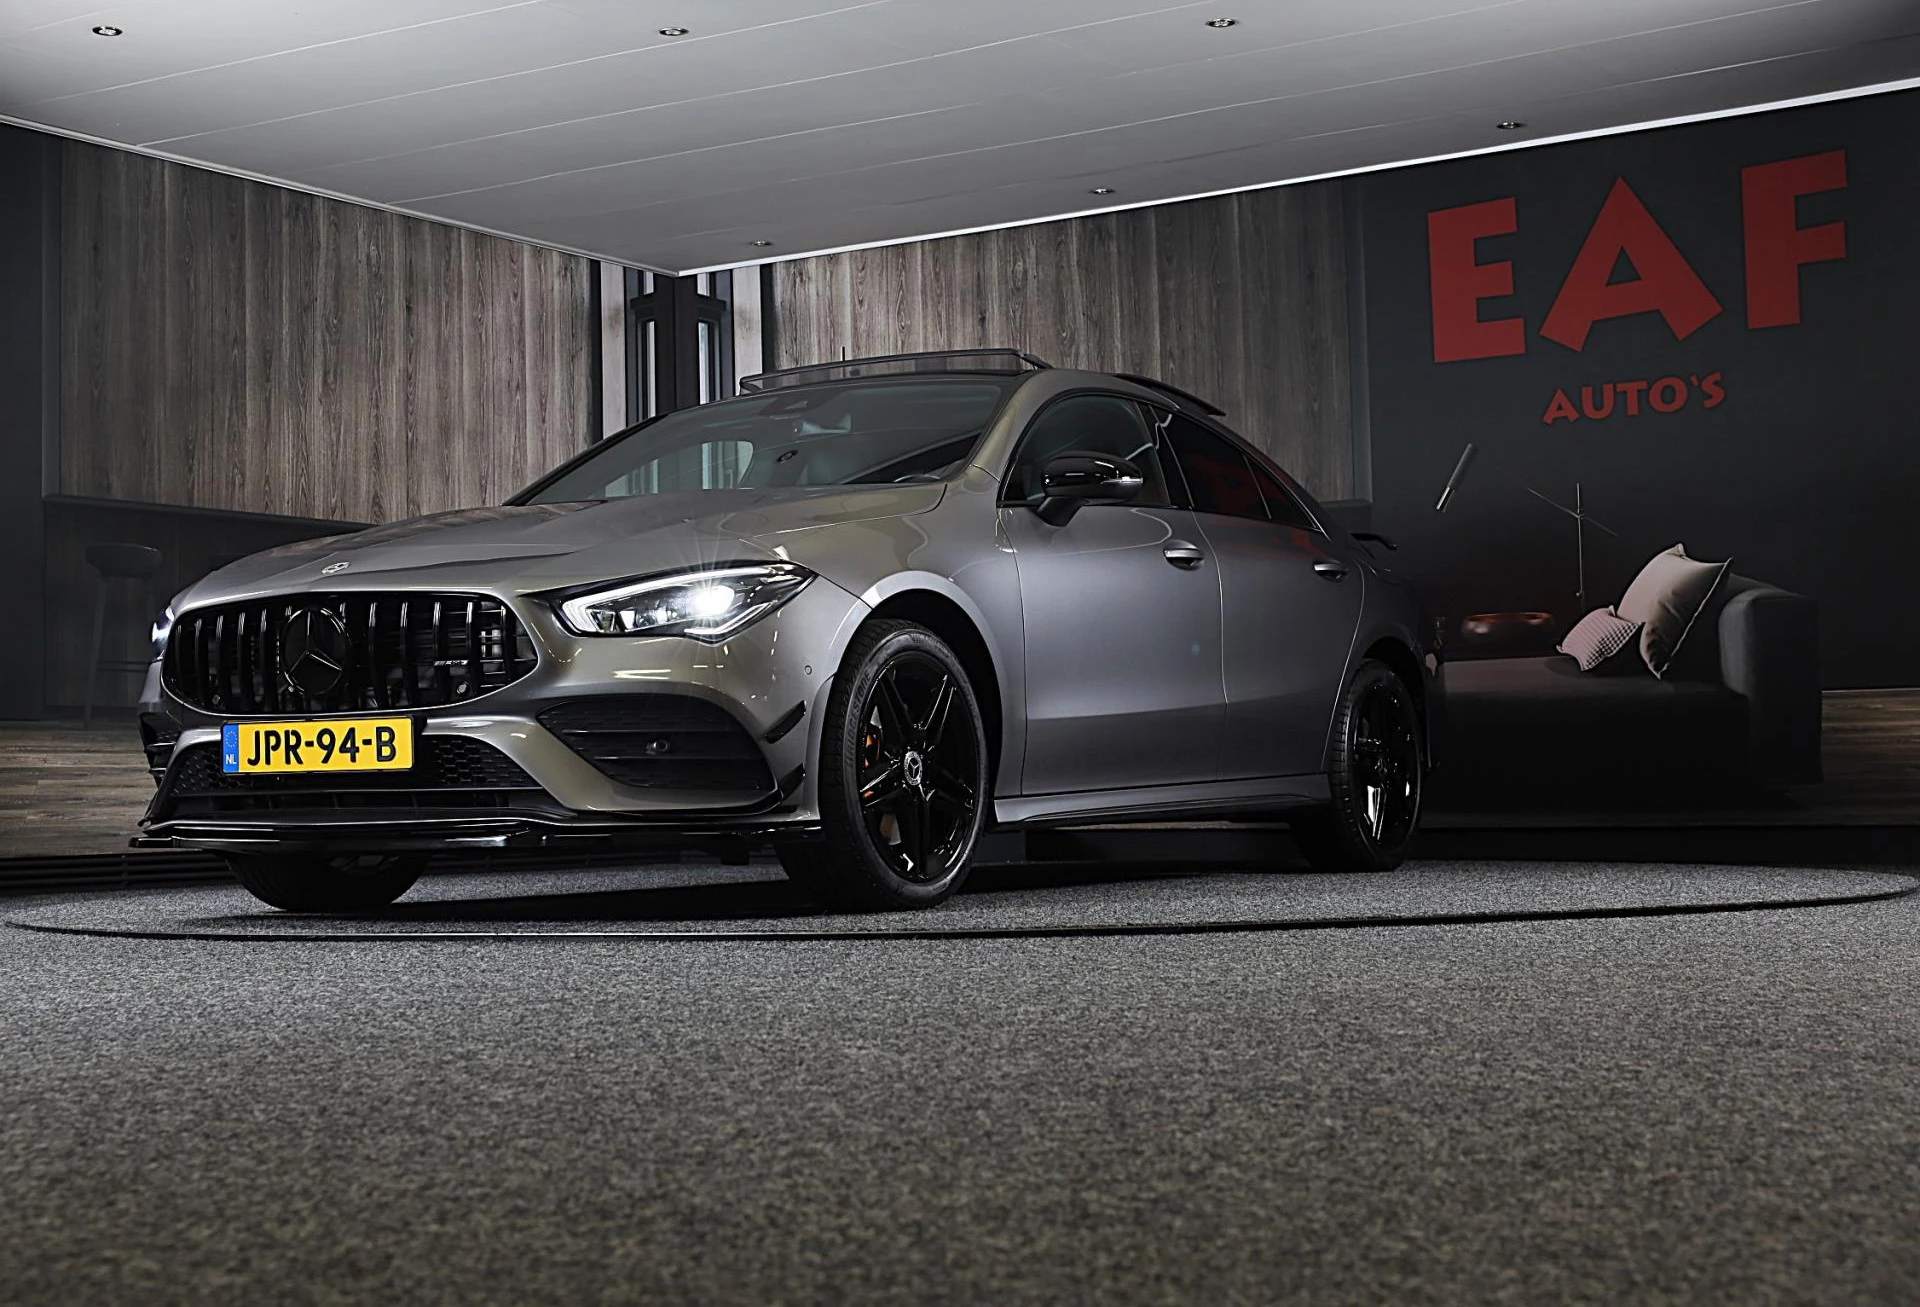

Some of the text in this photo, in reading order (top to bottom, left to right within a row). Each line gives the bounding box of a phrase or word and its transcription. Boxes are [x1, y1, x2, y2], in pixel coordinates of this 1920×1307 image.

[1427, 149, 1848, 363] EAF
[1542, 371, 1726, 425] AUTO'S
[225, 753, 237, 765] NL
[247, 726, 397, 766] JPR-94-B
